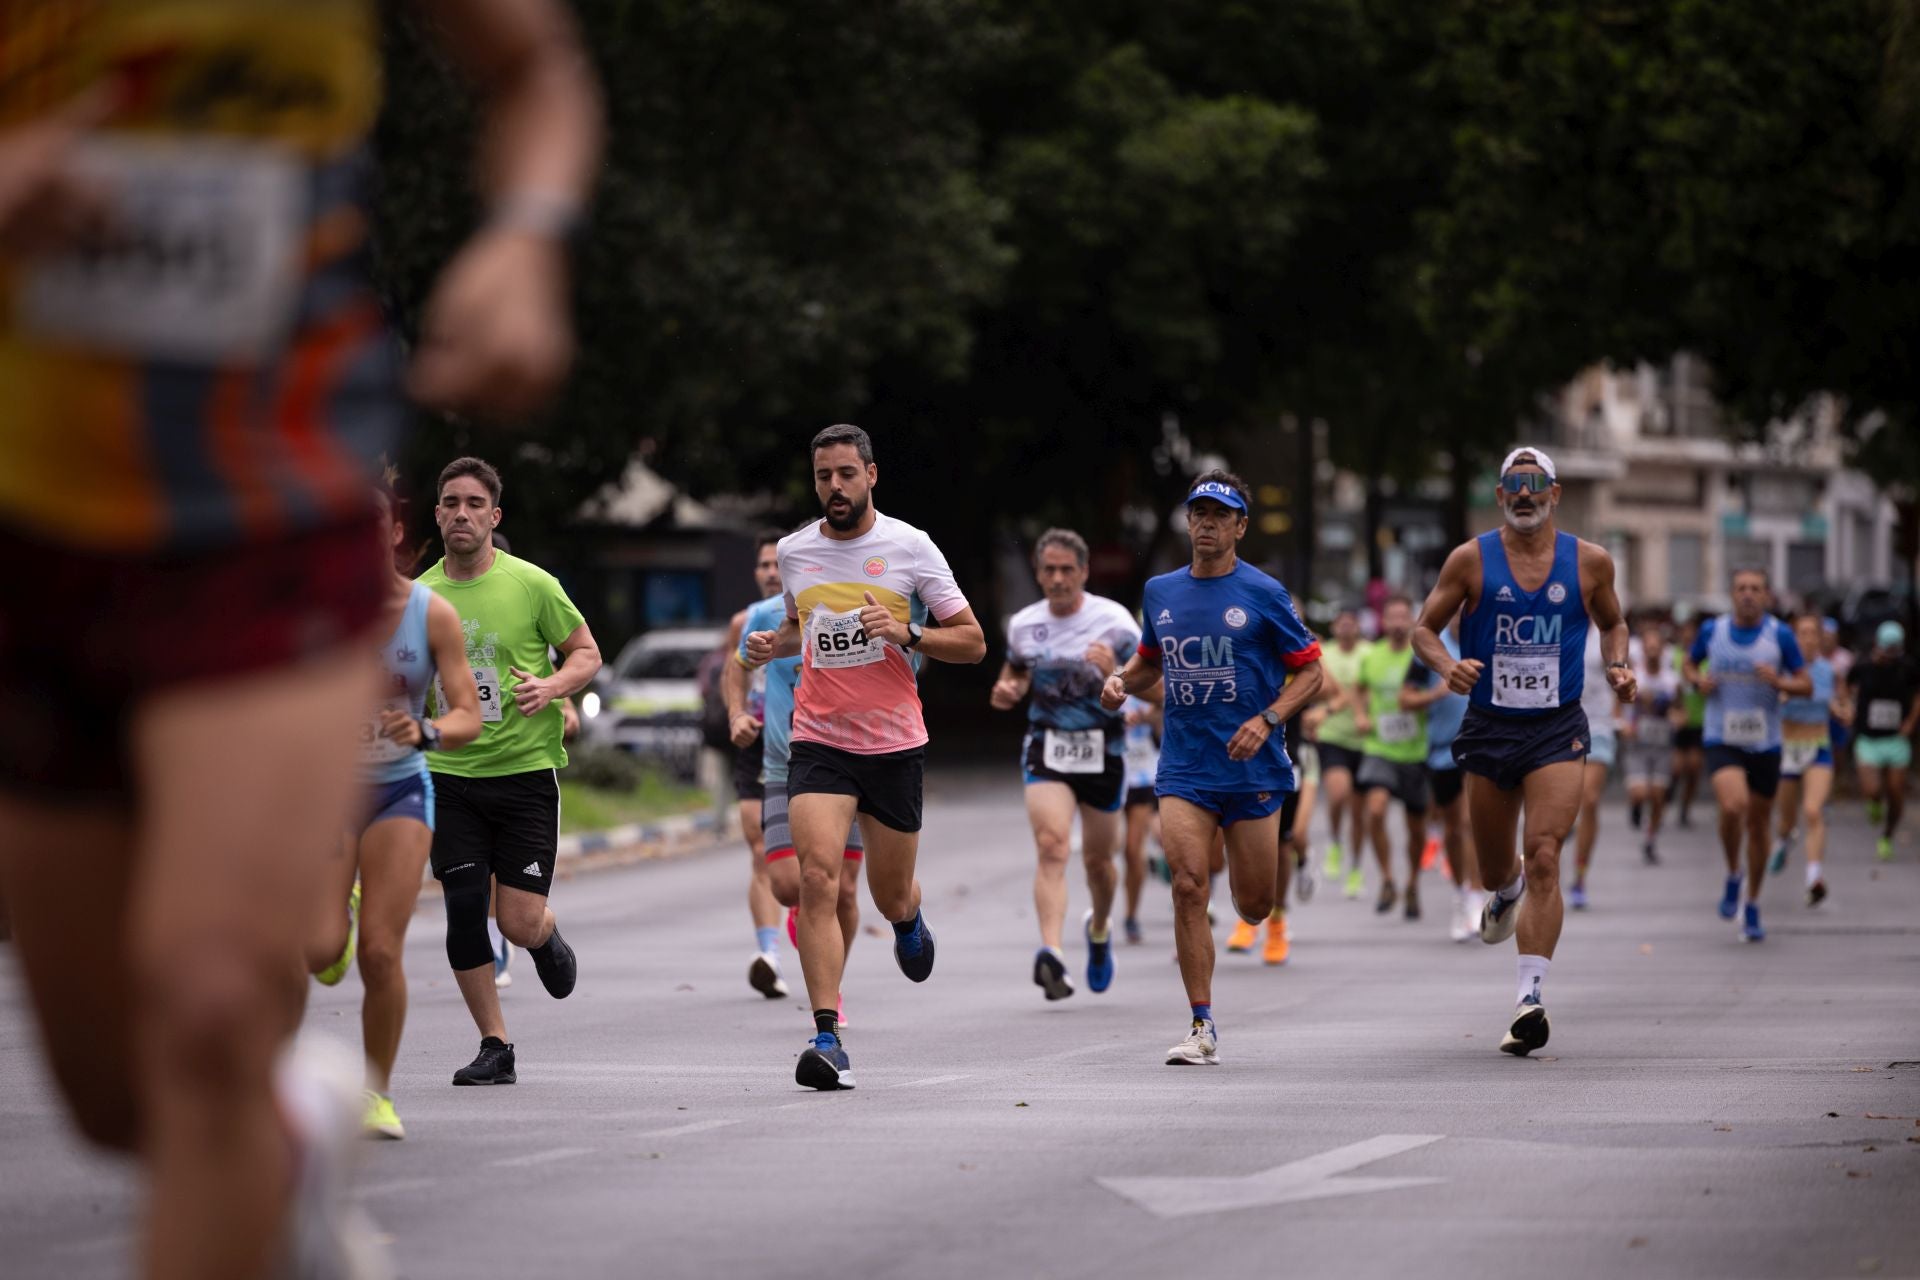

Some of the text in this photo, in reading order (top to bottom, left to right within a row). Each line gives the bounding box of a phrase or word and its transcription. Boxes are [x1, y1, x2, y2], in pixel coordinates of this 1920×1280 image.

[1196, 481, 1231, 496] RCM
[817, 628, 869, 652] 664
[1496, 613, 1562, 645] RCM
[1161, 635, 1235, 669] RCM
[1169, 680, 1237, 706] 1873
[1499, 674, 1550, 690] 1121
